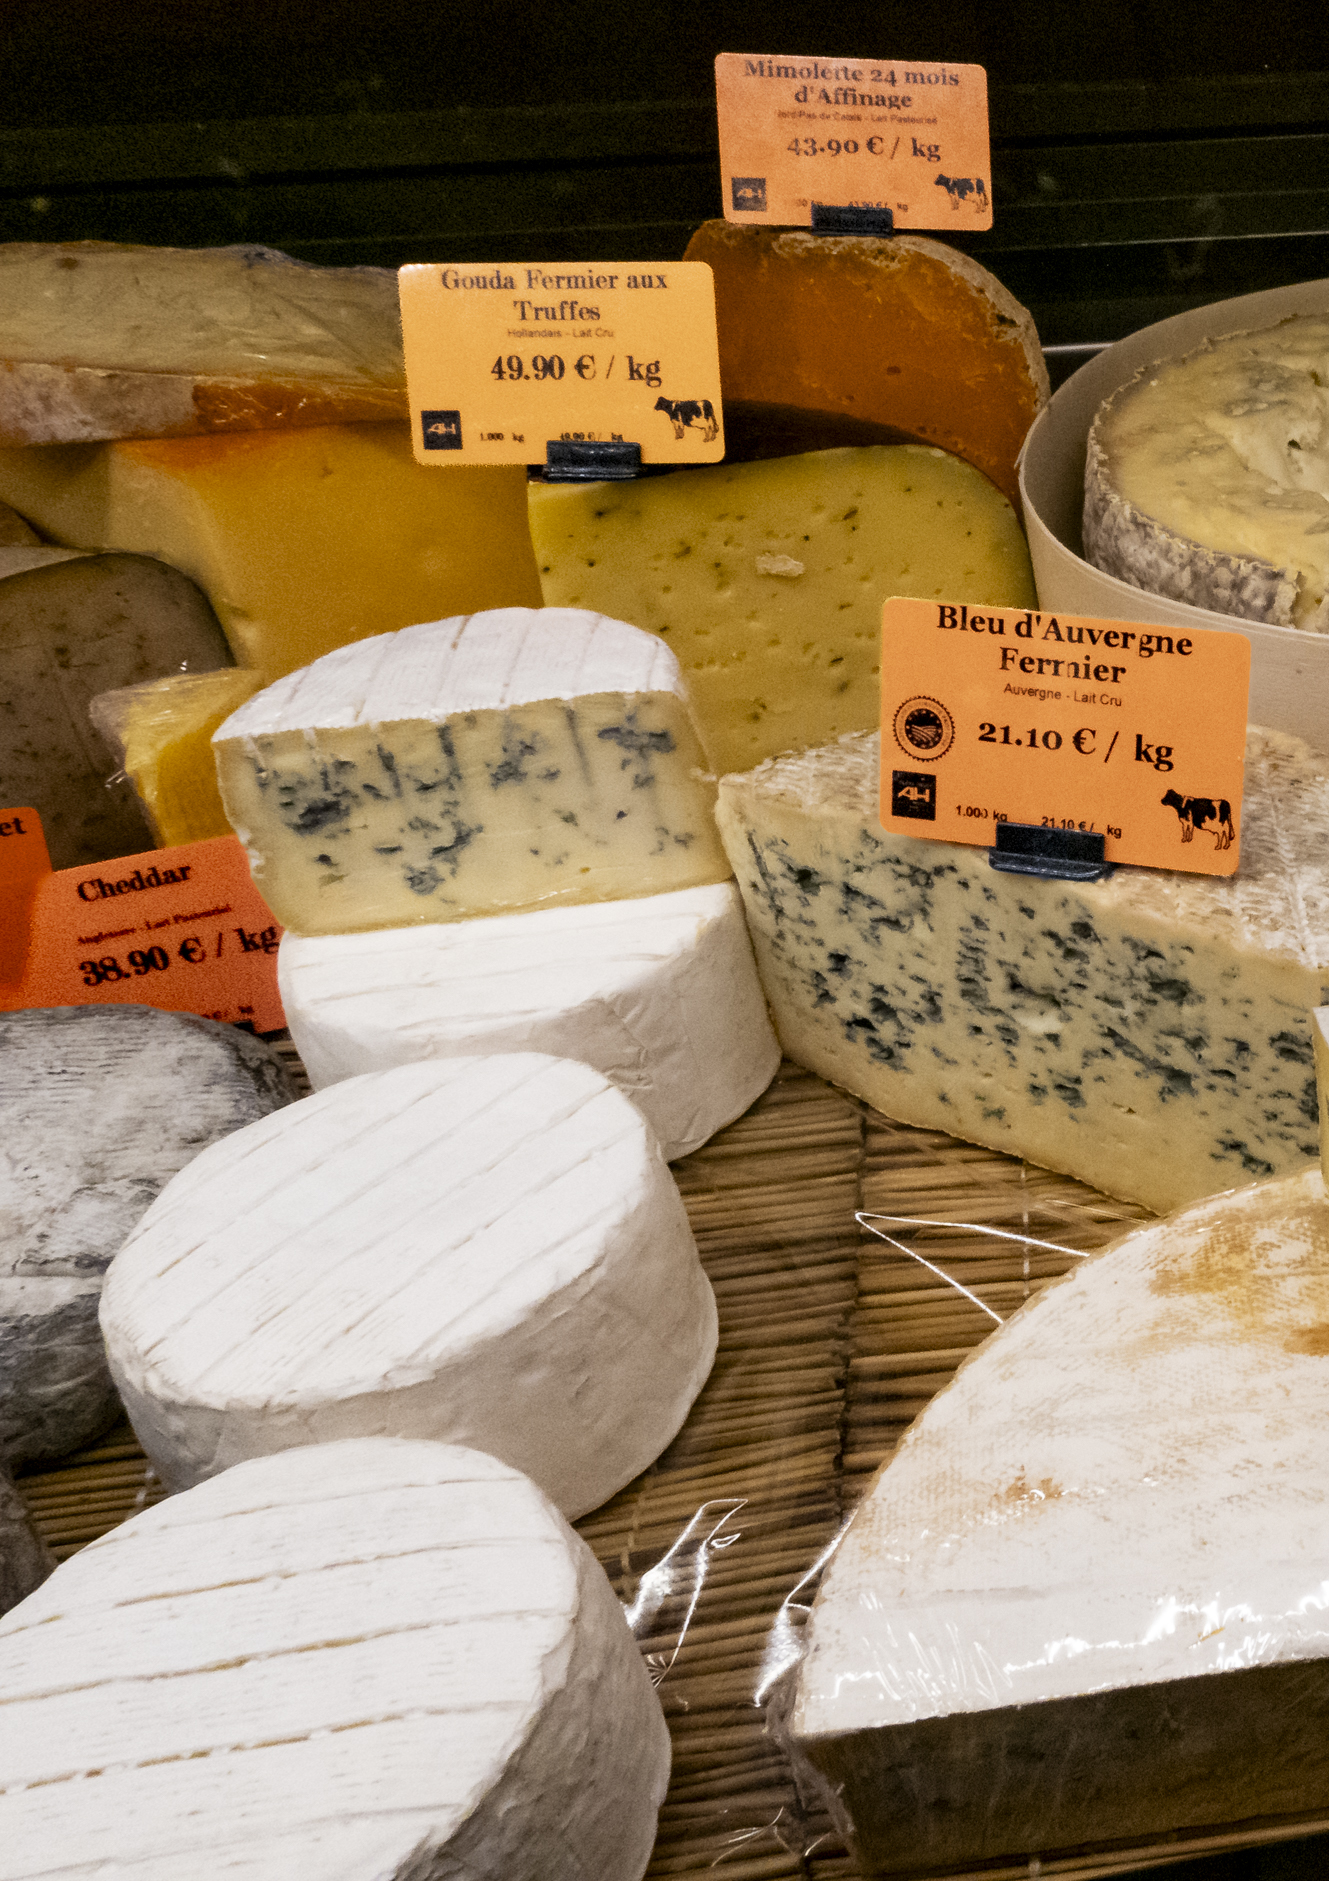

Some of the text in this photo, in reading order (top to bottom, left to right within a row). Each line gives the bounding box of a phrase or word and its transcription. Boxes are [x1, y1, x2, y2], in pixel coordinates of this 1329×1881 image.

[745, 59, 960, 87] Mimolette 24 mois
[794, 85, 913, 110] d'Affinage
[787, 137, 859, 157] 43.90
[867, 136, 885, 155] €
[912, 137, 941, 162] kg
[441, 269, 668, 290] Gouda Fermier aux
[513, 300, 601, 321] Truffes
[595, 327, 614, 338] Cru
[491, 354, 662, 388] 49.90 € / kg
[937, 605, 1193, 657] Bleu d'Auvergne
[1004, 683, 1061, 701] Auvergne
[1074, 690, 1096, 704] Lait
[1100, 693, 1122, 707] Cru
[978, 722, 1063, 751] 21.10
[1072, 728, 1096, 755] €
[1134, 734, 1174, 772] kg
[1107, 824, 1122, 839] kg
[77, 865, 191, 902] Cheddar
[79, 946, 169, 986] 38.90
[178, 937, 206, 964] €
[233, 926, 279, 955] kg
